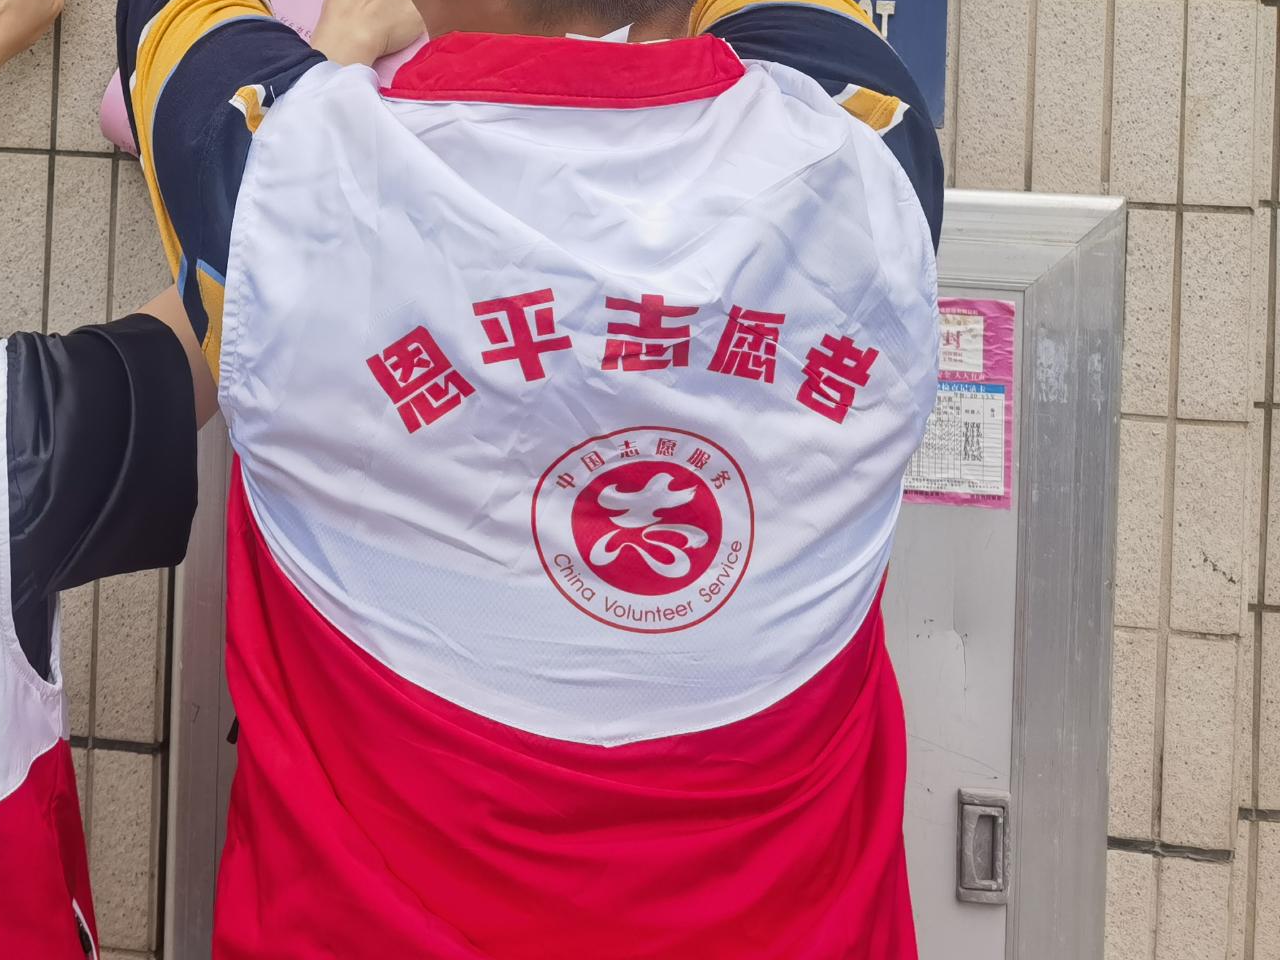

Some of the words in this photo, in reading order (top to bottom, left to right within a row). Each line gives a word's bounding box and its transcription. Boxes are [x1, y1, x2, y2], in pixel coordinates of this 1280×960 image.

[366, 288, 880, 434] 恩平志愿者
[556, 437, 733, 490] 中国志愿服务
[554, 551, 596, 603] China
[604, 598, 696, 623] Volunteer
[699, 539, 743, 603] Service
